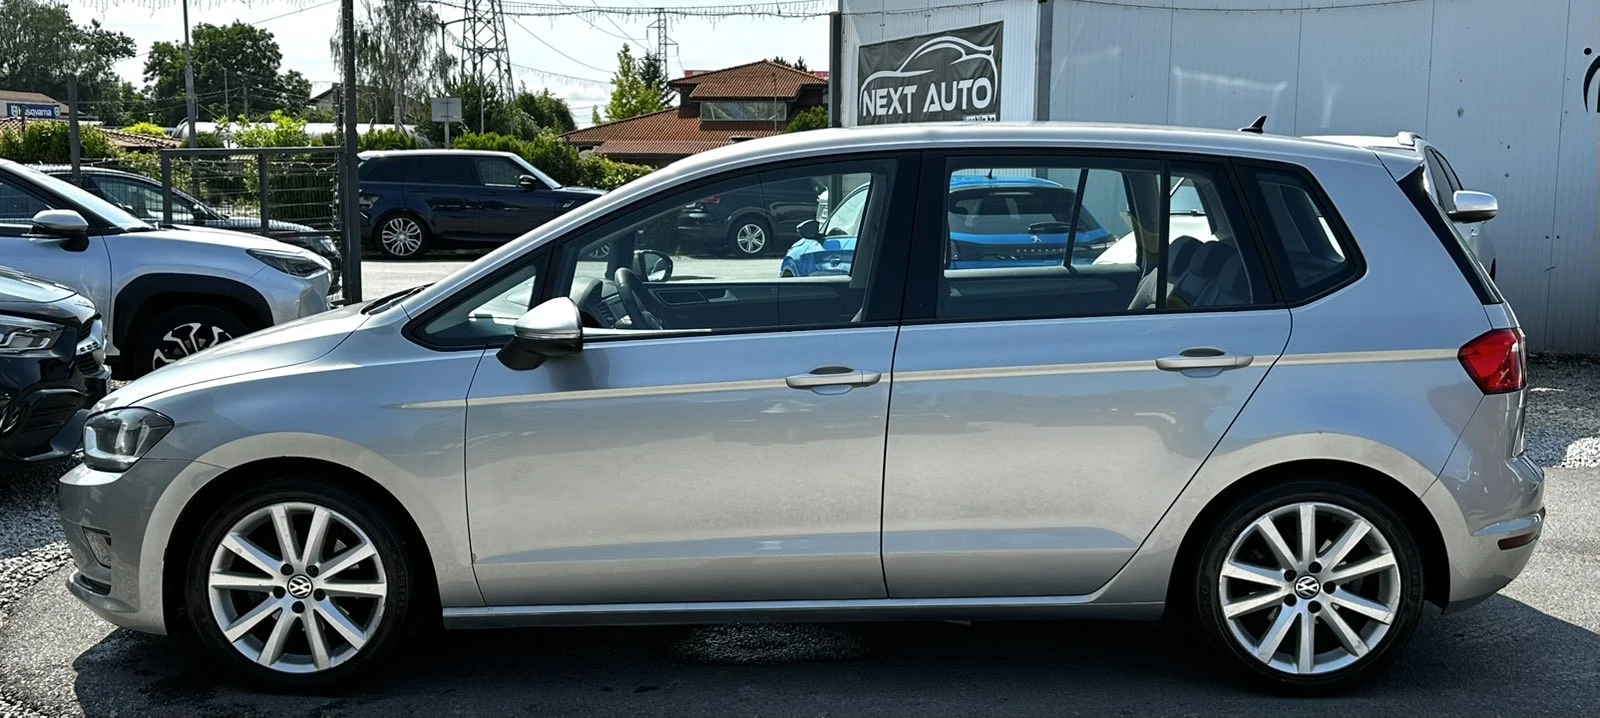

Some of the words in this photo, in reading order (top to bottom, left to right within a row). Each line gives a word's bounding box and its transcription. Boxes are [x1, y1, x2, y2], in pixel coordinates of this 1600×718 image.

[862, 85, 918, 116] NEXT
[923, 77, 992, 113] AUTO
[18, 106, 51, 116] Hsqvarna
